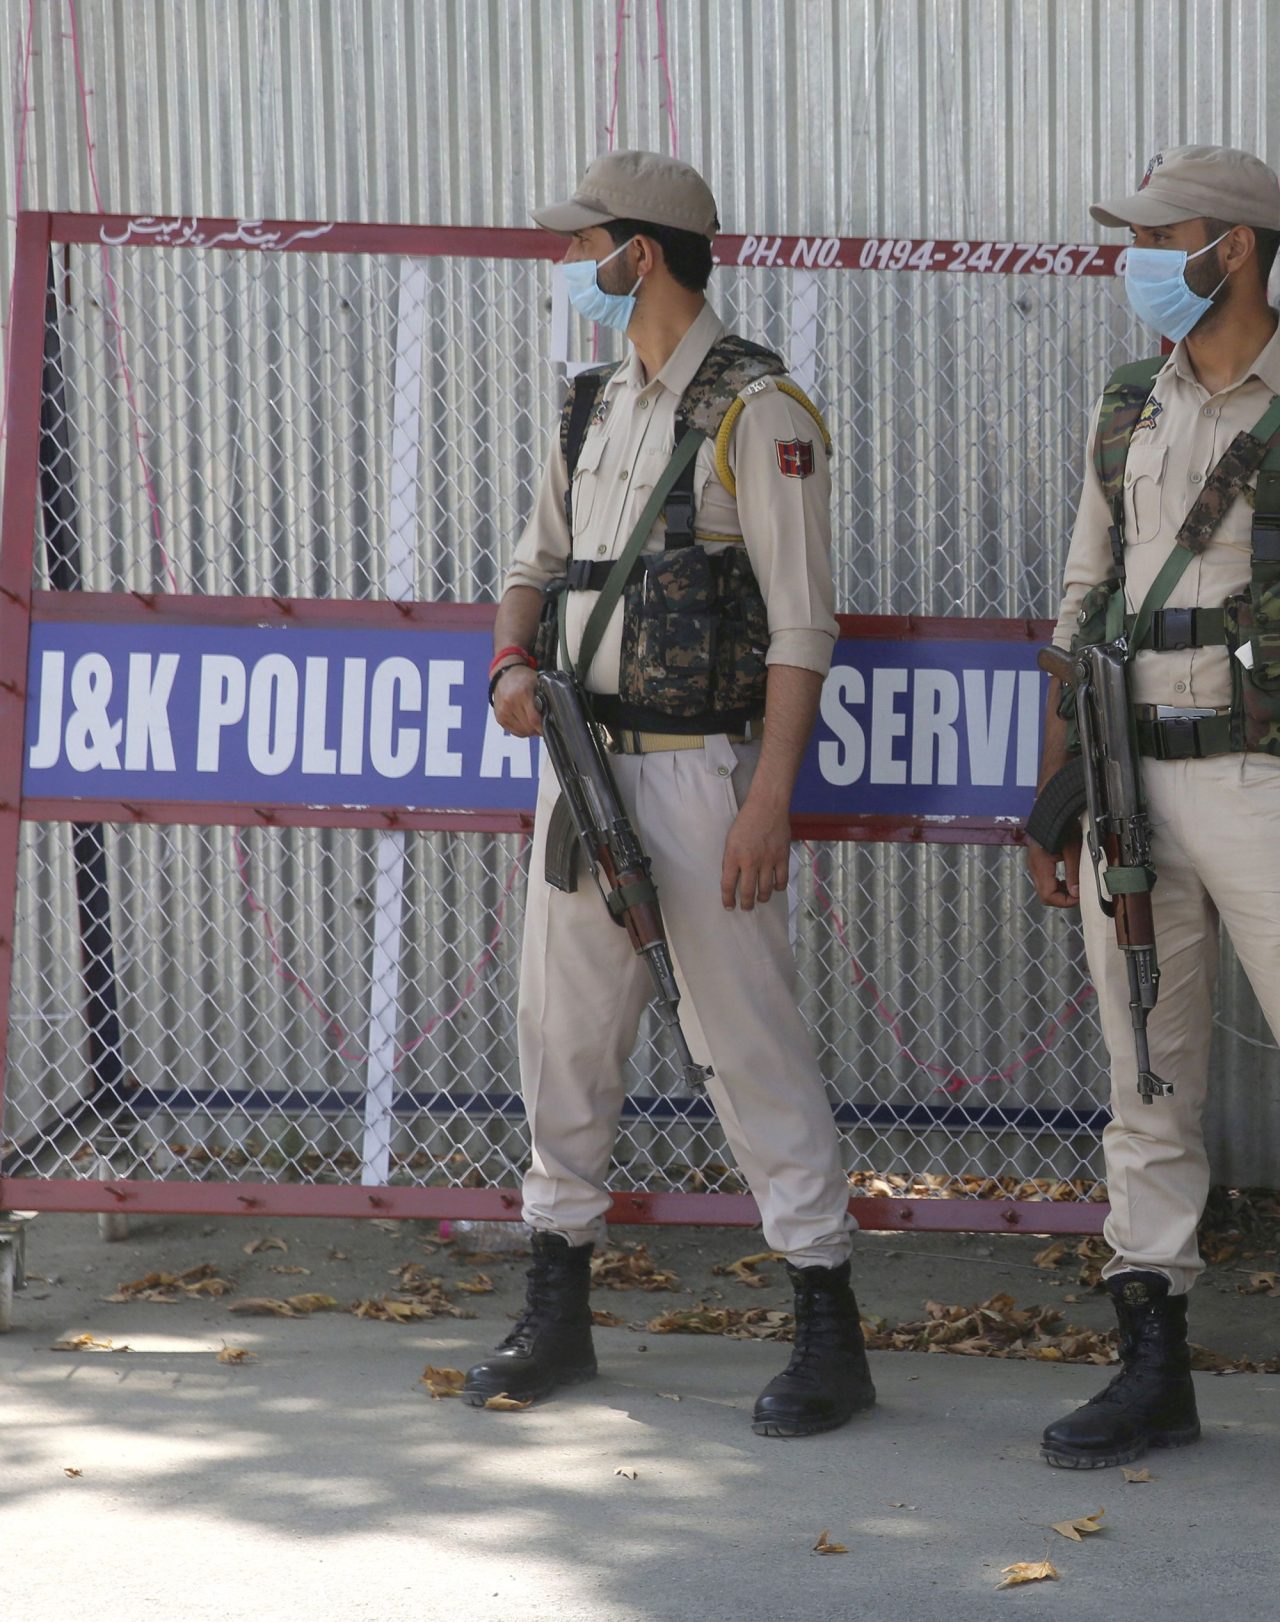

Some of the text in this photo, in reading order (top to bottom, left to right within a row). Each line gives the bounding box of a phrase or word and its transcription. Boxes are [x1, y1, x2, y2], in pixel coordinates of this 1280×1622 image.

[736, 235, 784, 267] PH.
[790, 237, 843, 268] NO.
[29, 649, 181, 773] J&K
[196, 652, 466, 779] POLICE
[818, 664, 1040, 787] SERVI
